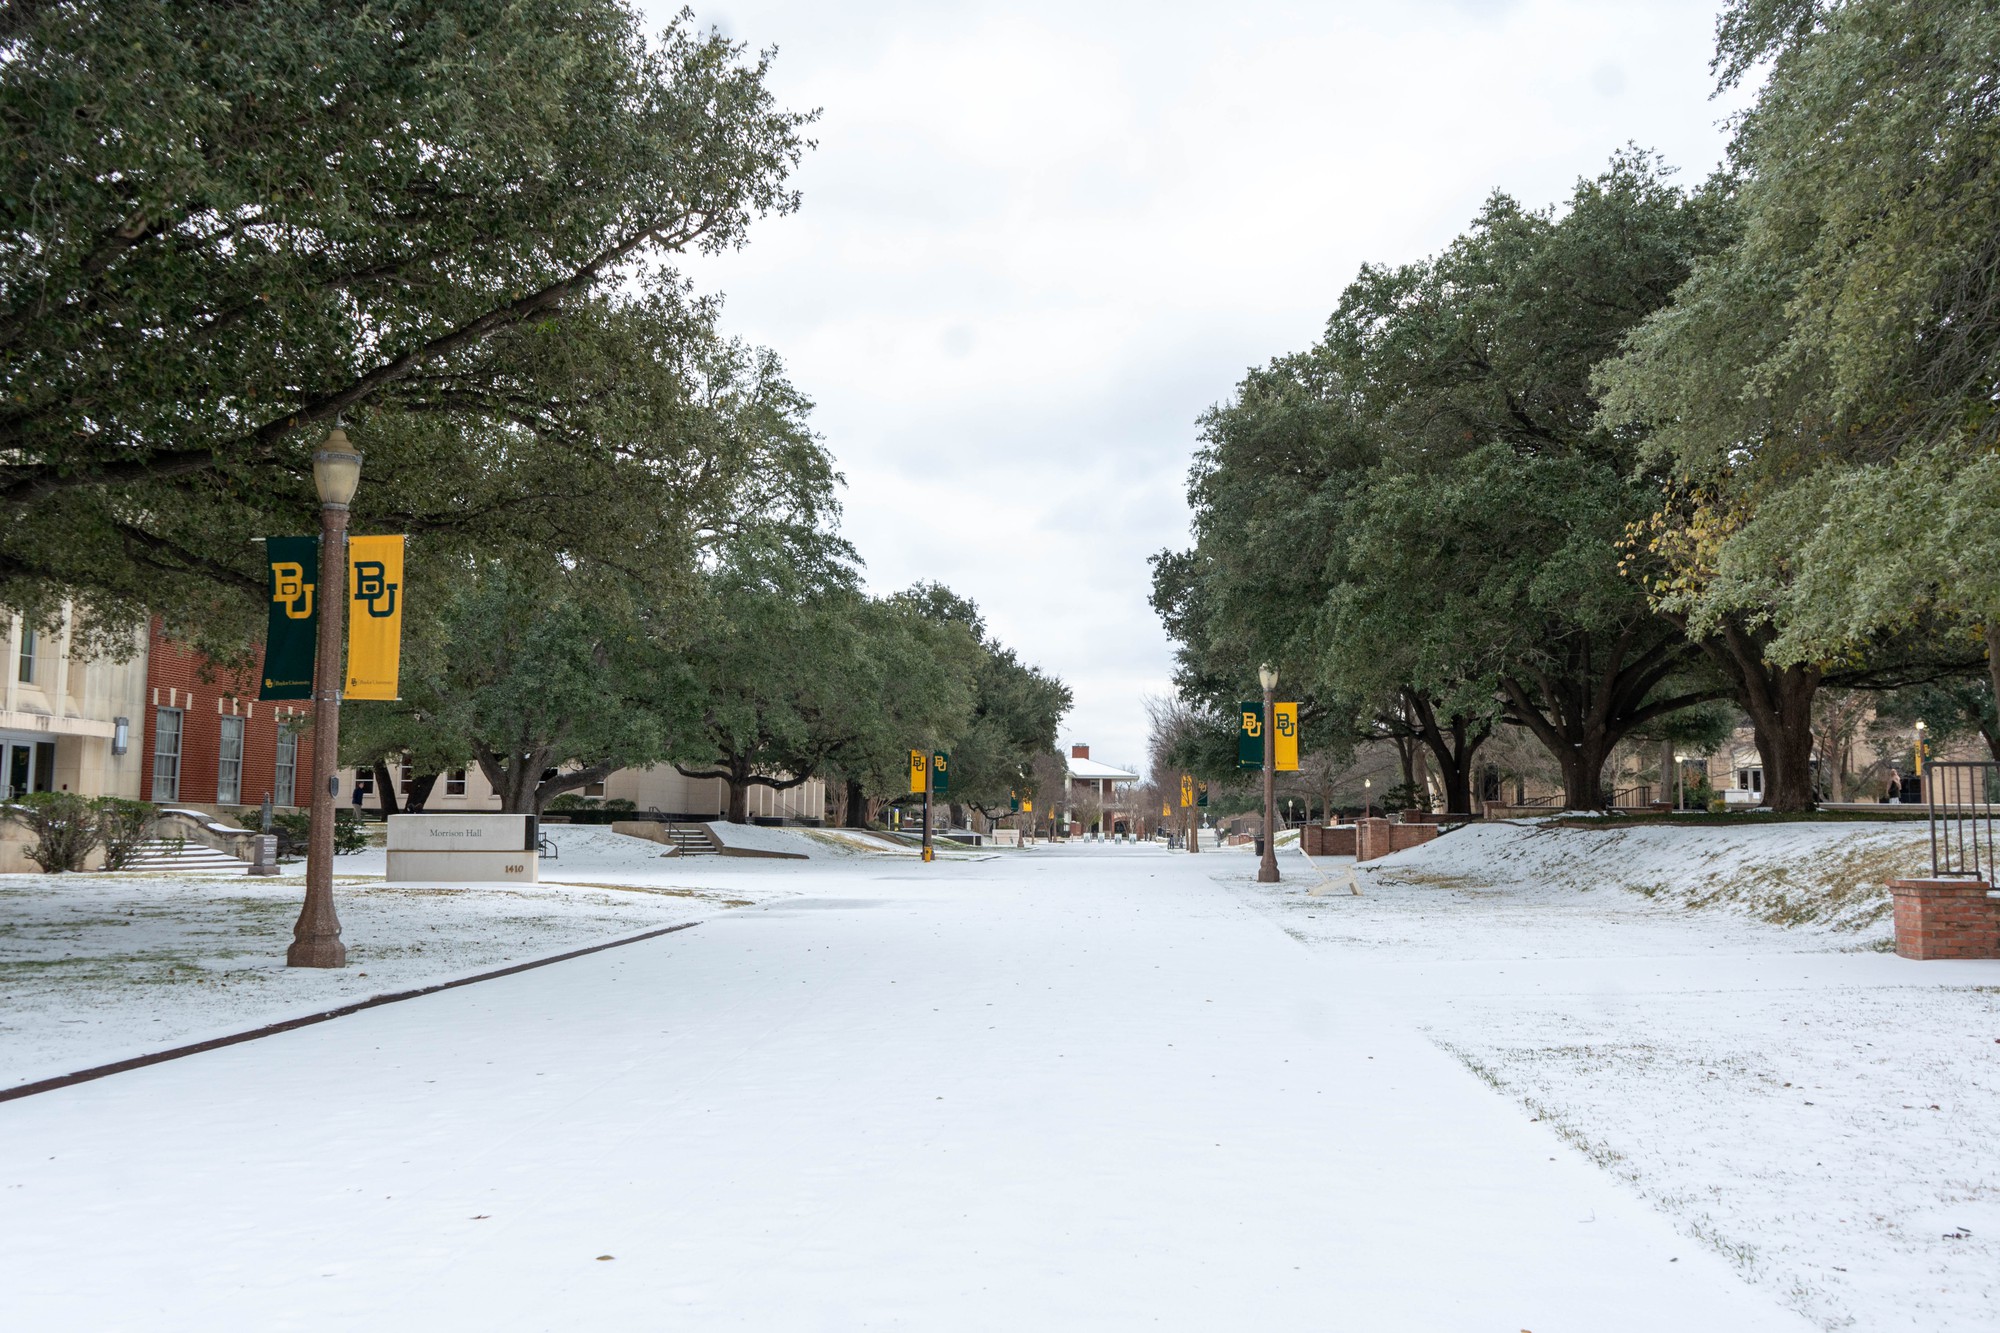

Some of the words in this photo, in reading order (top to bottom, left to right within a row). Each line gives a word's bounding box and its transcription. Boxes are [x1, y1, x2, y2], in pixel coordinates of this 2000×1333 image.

[272, 562, 314, 619] BU
[354, 561, 398, 618] BU
[1242, 712, 1262, 737] BU
[1276, 713, 1295, 737] BU
[934, 756, 947, 771] BU
[430, 829, 464, 837] Morrison
[466, 829, 482, 837] Hall
[505, 865, 524, 873] 1410
